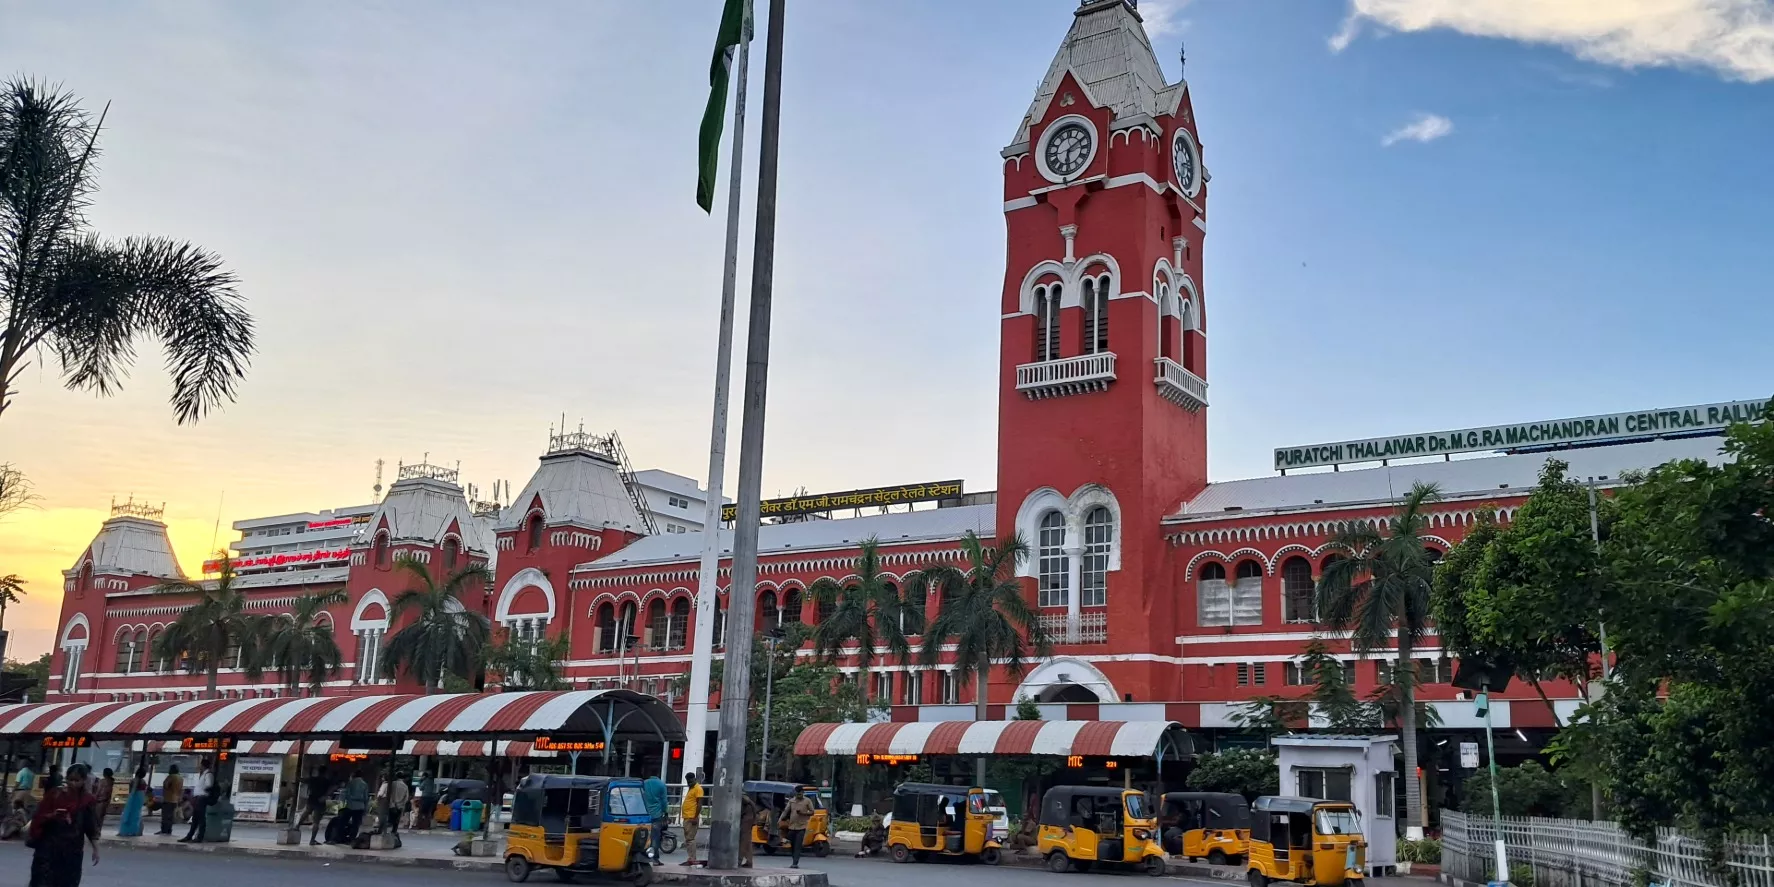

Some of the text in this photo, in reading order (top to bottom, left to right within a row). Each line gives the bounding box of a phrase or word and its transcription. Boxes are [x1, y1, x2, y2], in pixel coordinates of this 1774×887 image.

[1276, 445, 1343, 466] PURATCHI
[1347, 436, 1425, 459] THALAIVAR
[1625, 409, 1704, 433] CENTRAL
[901, 486, 926, 499] रेलवे
[928, 483, 960, 497] स्टेशन
[535, 737, 550, 749] MTC
[857, 754, 870, 764] MTC
[1068, 756, 1083, 767] MTC
